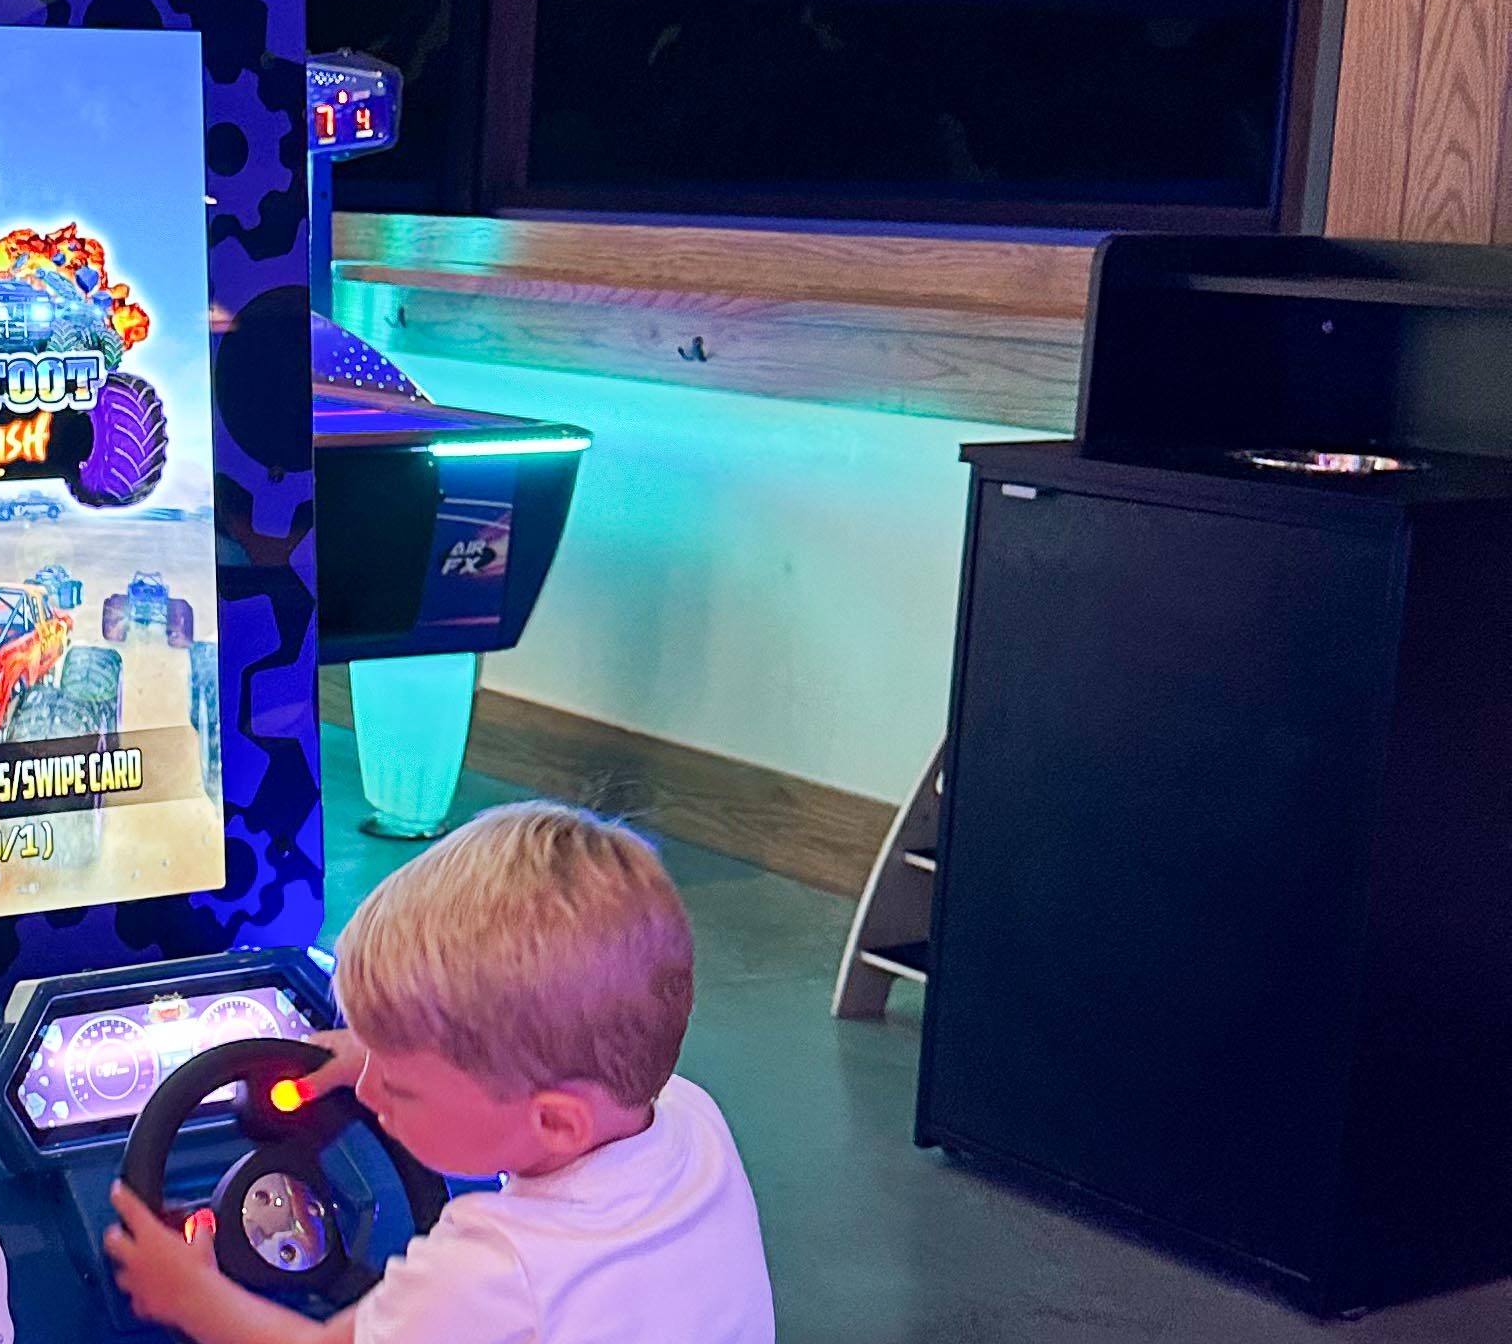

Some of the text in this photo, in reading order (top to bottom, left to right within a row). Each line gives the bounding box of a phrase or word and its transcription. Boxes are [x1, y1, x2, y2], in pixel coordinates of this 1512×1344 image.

[449, 539, 487, 557] AIR
[441, 556, 481, 575] FX
[89, 747, 144, 793] CARD
